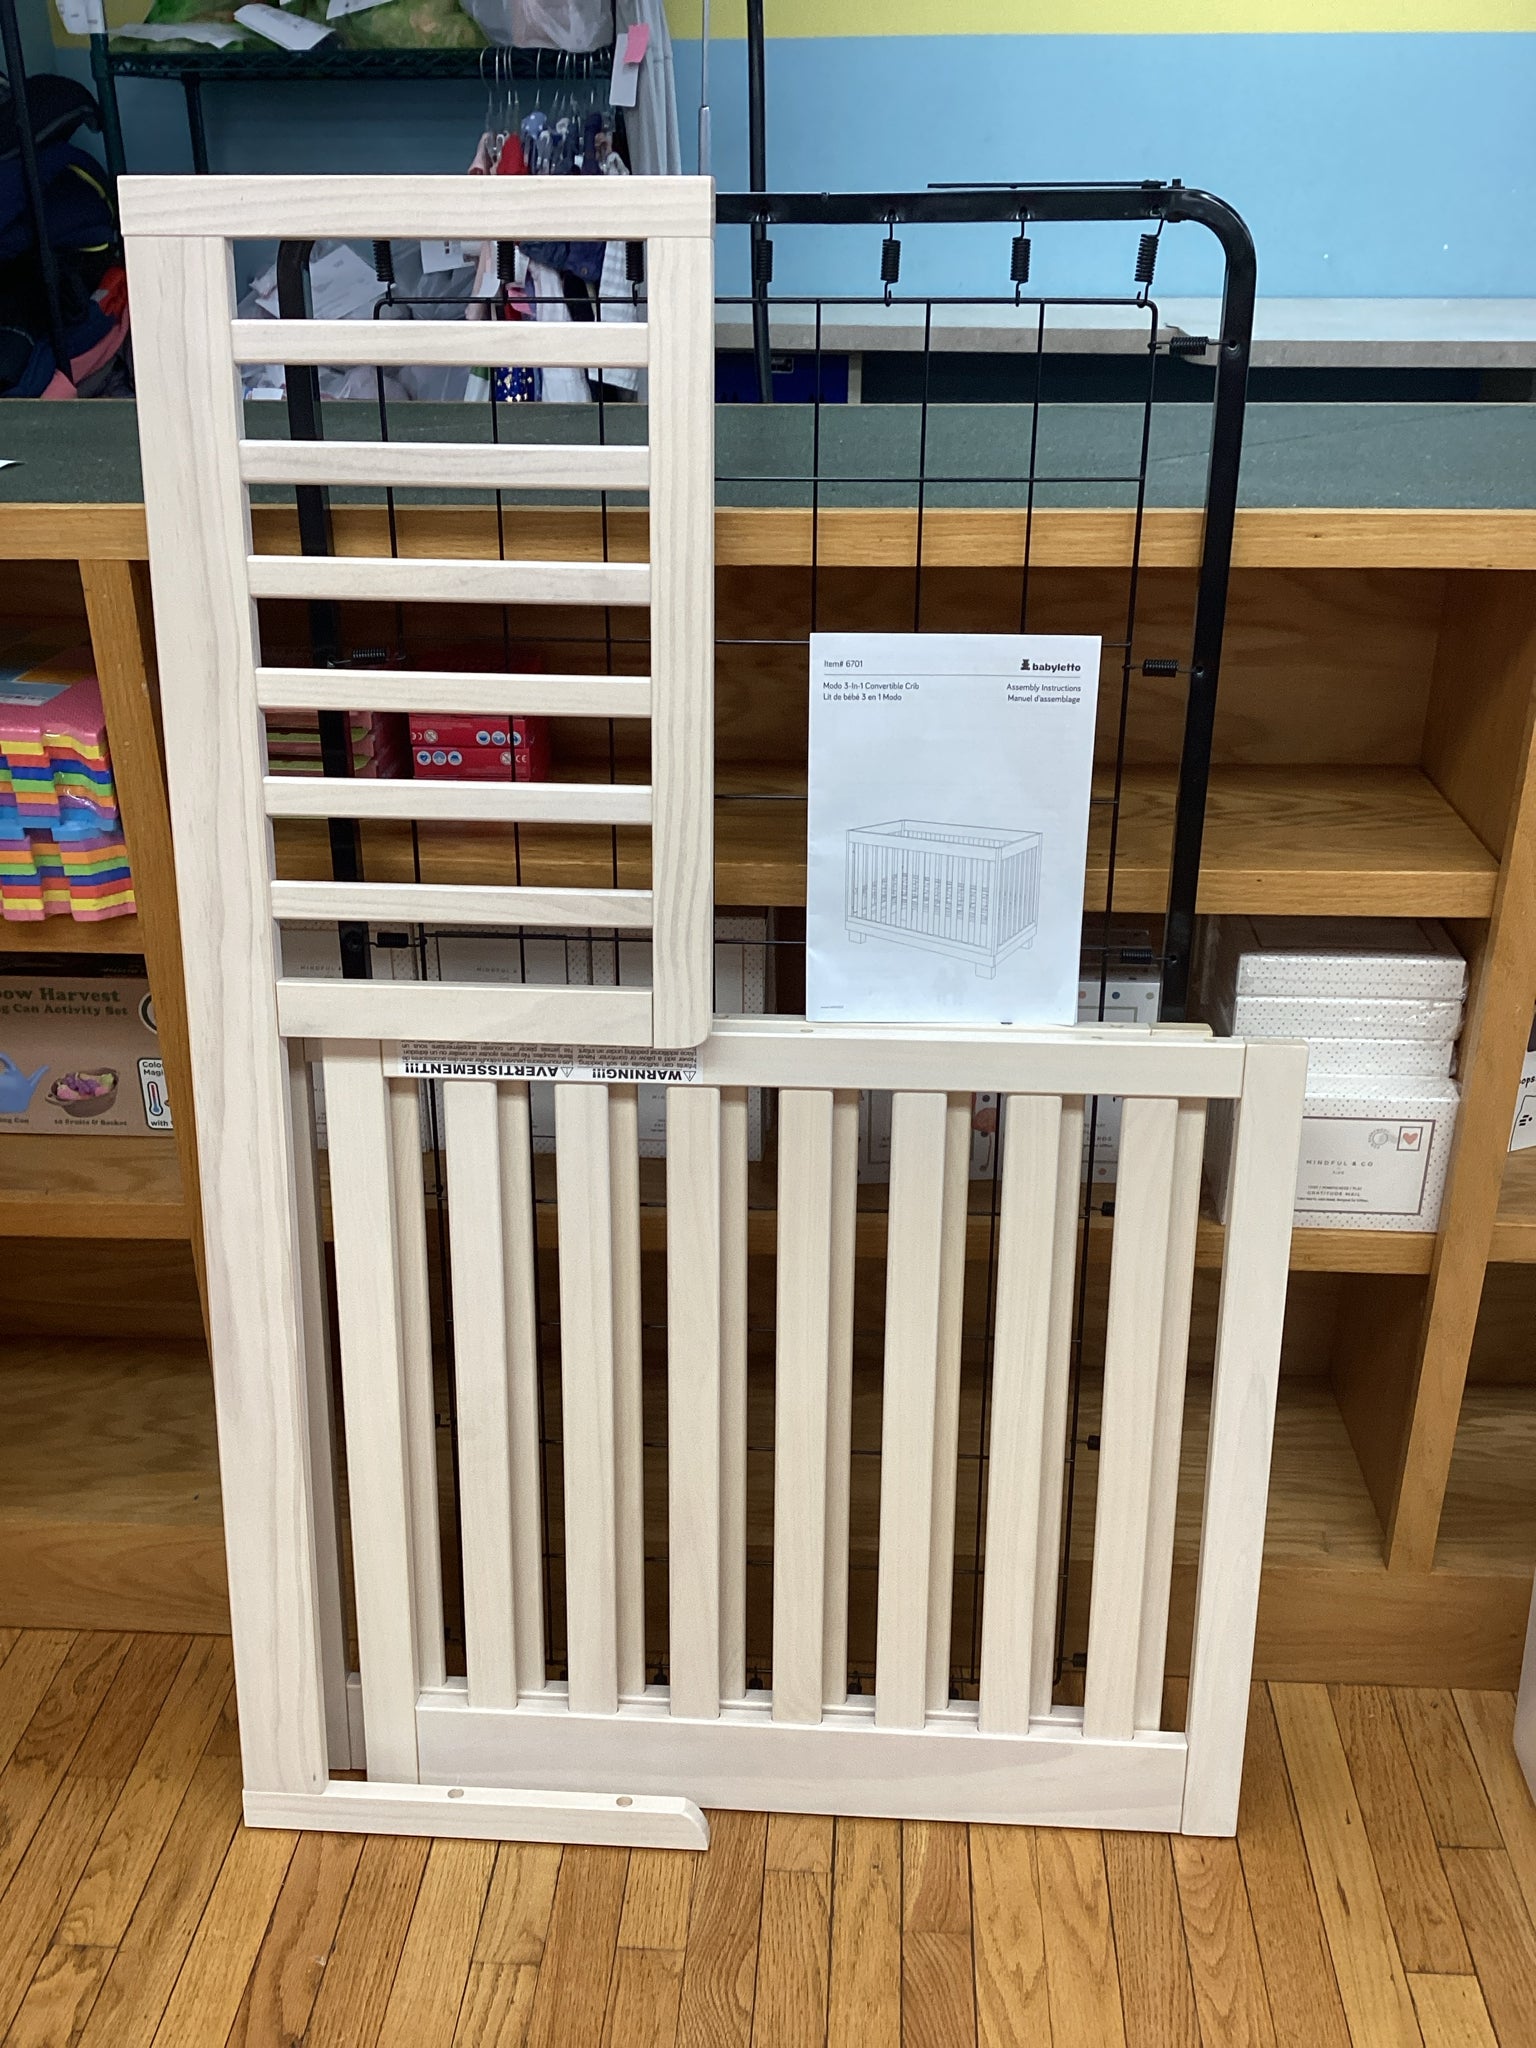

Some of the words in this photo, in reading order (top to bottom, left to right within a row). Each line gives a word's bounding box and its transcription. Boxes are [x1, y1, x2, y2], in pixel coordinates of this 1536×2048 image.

[824, 660, 843, 668] Item#
[846, 660, 863, 668] 6701
[1032, 663, 1081, 673] babyletto
[823, 682, 842, 690] Modo
[844, 682, 863, 690] 3-In-1
[865, 682, 903, 690] Convertible
[905, 682, 920, 690] Crib
[1006, 684, 1040, 692] Assembly
[1042, 684, 1081, 692] Instructions
[883, 693, 902, 701] Modo
[1008, 694, 1032, 702] Manuel
[1034, 695, 1080, 704] d'assemblage
[40, 987, 120, 1002] Harvest
[13, 1004, 39, 1013] Can
[44, 1004, 100, 1016] Activity
[105, 1006, 128, 1015] Set
[405, 1063, 558, 1077] AVERTISSEMENT!!!
[592, 1068, 682, 1080] WARNING!!!
